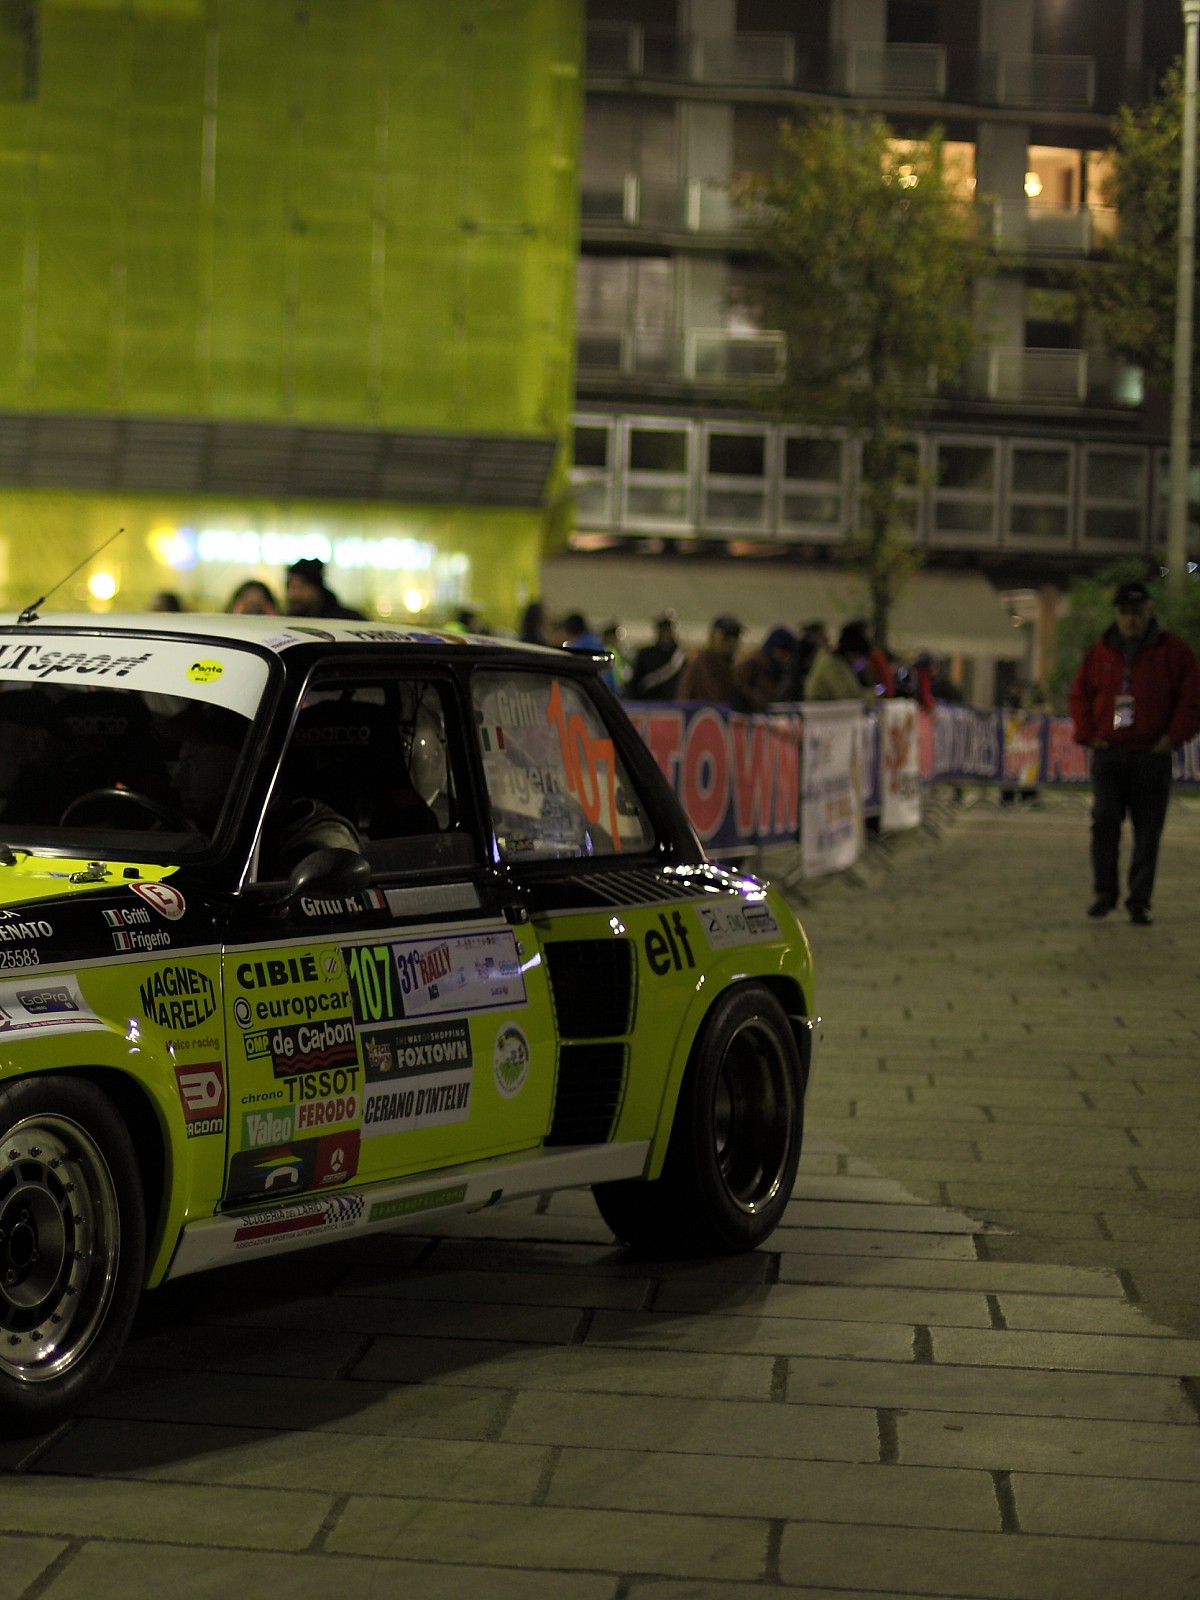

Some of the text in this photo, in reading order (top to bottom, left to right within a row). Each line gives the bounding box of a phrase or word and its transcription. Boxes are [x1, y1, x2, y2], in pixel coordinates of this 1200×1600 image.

[28, 651, 154, 678] sport
[547, 679, 622, 853] 107
[121, 907, 151, 926] Gritti
[130, 928, 172, 951] Frigerio
[644, 910, 696, 976] elf
[236, 952, 319, 990] CIBIÉ
[420, 946, 452, 986] RALLY
[20, 991, 68, 1007] GoPro
[139, 966, 217, 1000] MAGNETI
[349, 945, 394, 1021] 107
[139, 998, 217, 1030] MARELLI
[255, 990, 349, 1020] europcar
[192, 1037, 220, 1050] racing
[245, 1035, 270, 1055] OMP
[272, 1021, 355, 1057] de Carbon
[396, 1039, 469, 1069] FOXTOWN
[241, 1067, 360, 1105] chrono TISSOT
[298, 1096, 357, 1129] FERODO
[365, 1082, 471, 1125] CERANO D'INTELVI
[185, 1119, 223, 1137] ACOM
[246, 1112, 292, 1147] Valeo
[243, 1208, 285, 1227] SCUDERIA
[297, 1201, 322, 1217] LARIO
